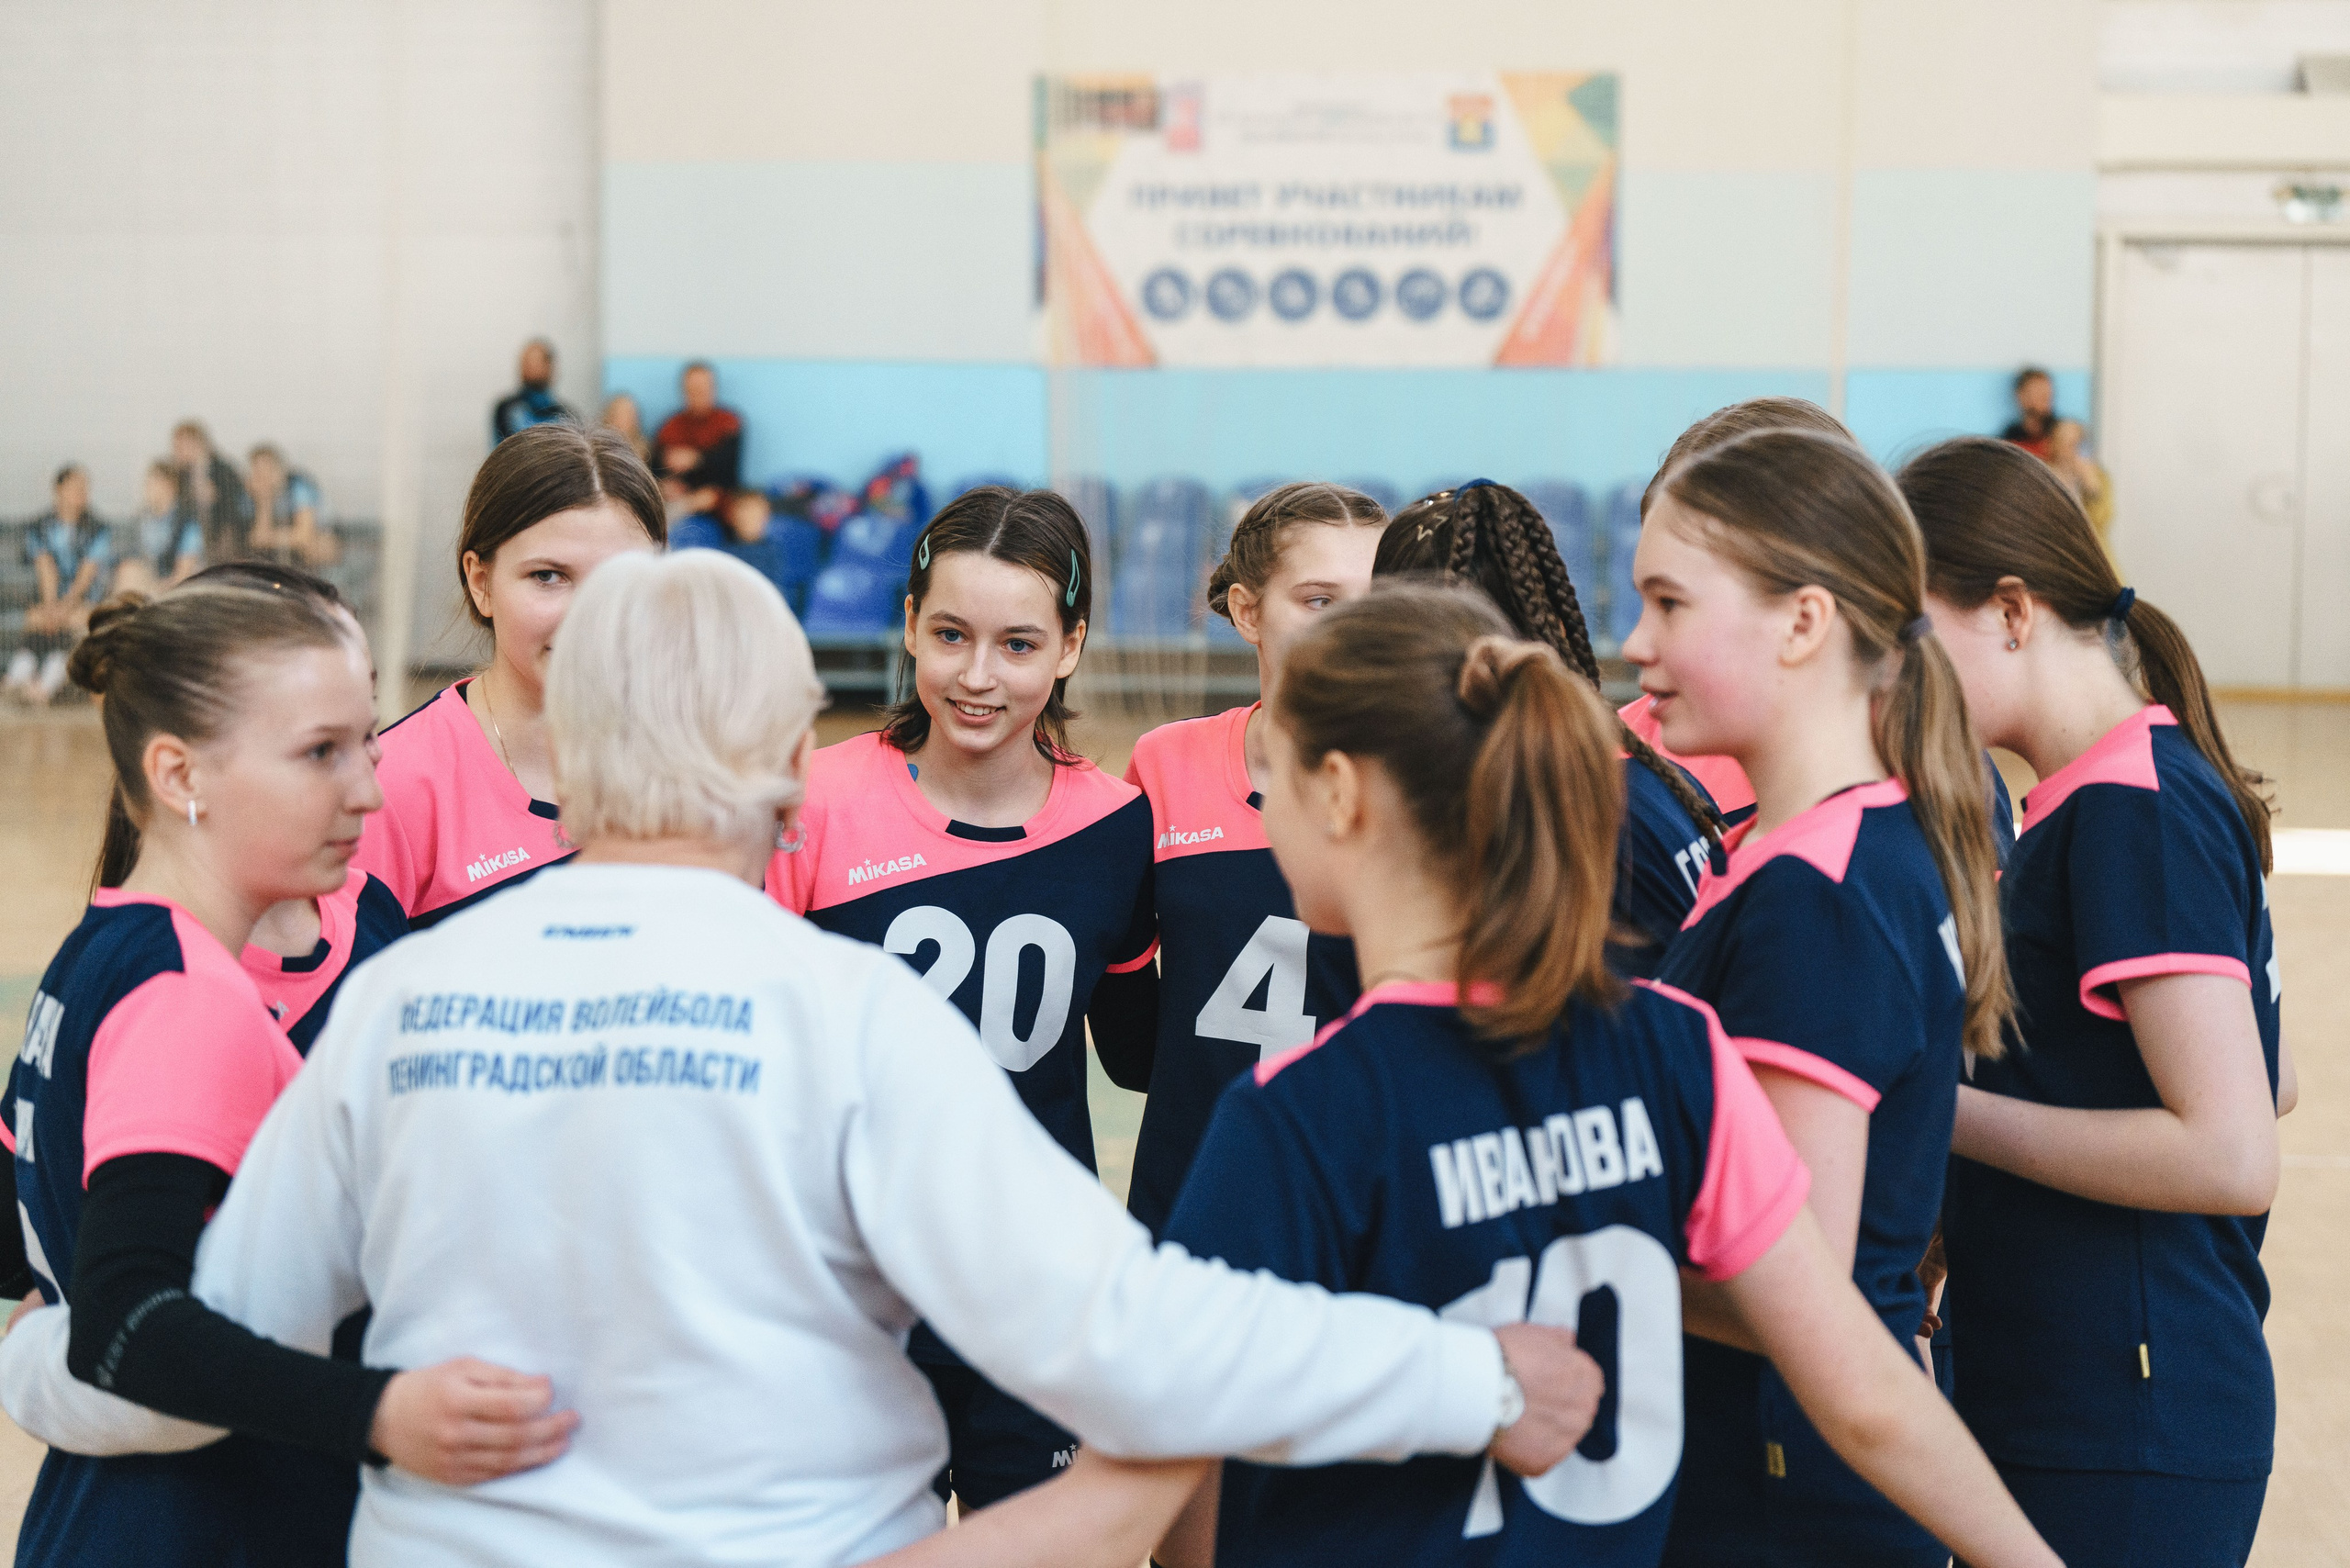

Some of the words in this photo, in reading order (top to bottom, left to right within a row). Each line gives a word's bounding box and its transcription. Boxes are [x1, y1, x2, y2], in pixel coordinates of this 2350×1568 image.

[569, 983, 754, 1036] ВОЛЕЙБОЛА
[883, 905, 1076, 1072] 20
[1195, 915, 1316, 1064] 4
[614, 1047, 762, 1095] ОБЛАСТИ
